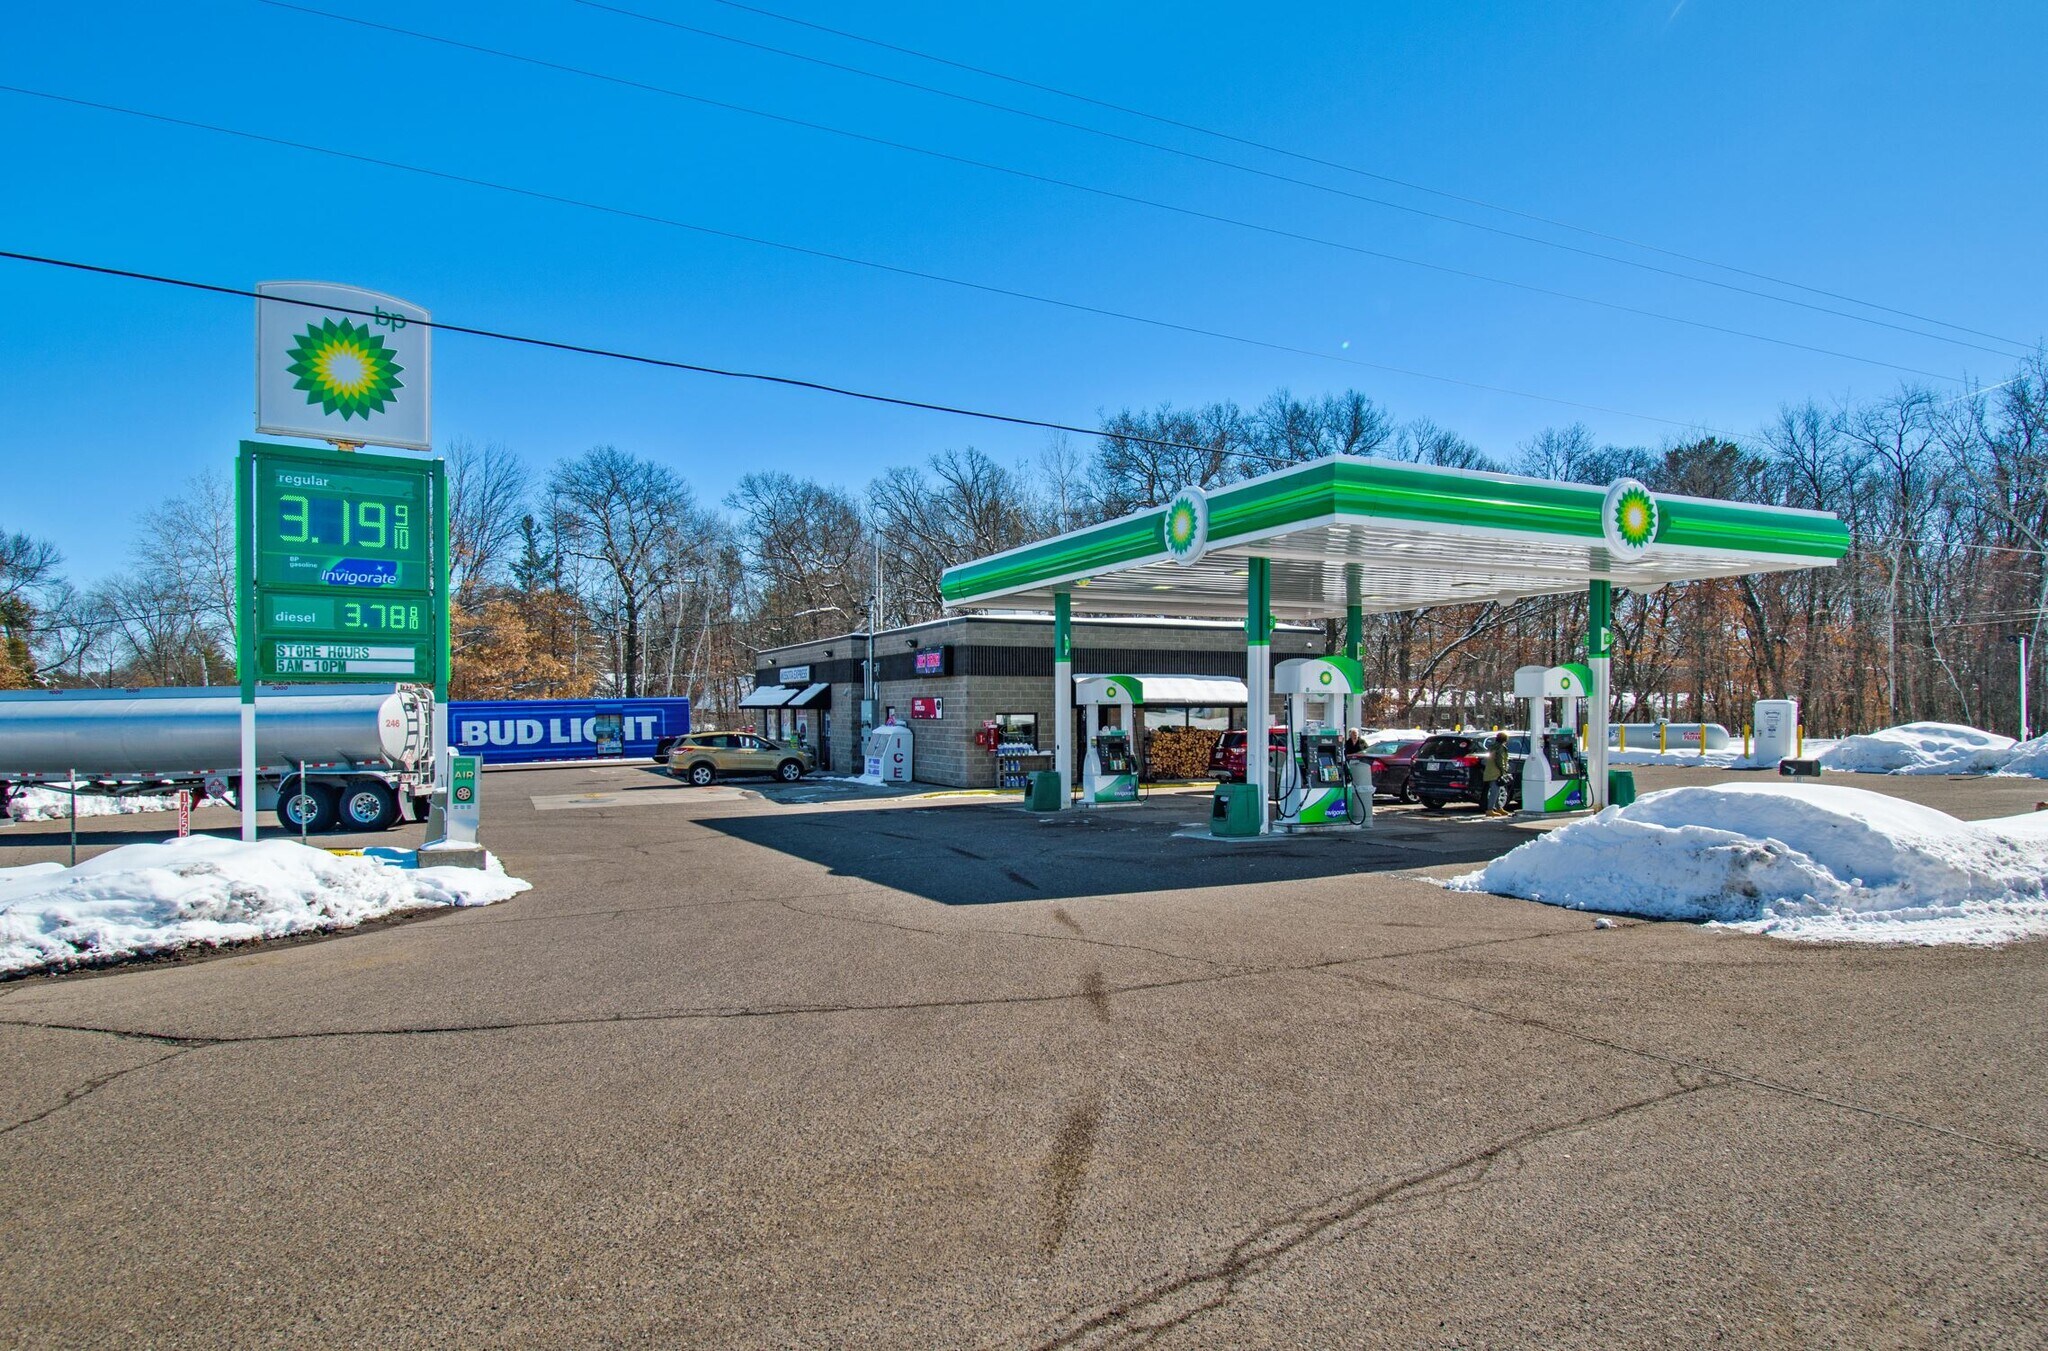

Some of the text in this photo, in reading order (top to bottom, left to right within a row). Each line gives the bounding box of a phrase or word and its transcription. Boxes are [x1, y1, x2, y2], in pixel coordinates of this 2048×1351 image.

[374, 305, 407, 332] bp
[279, 474, 329, 487] regular
[280, 494, 386, 548] 3.19
[289, 561, 318, 569] gasoline
[321, 568, 397, 585] Invigorate
[275, 612, 316, 623] diesel
[345, 602, 406, 629] 3.78
[278, 645, 370, 658] STORE HOURS
[385, 719, 400, 728] 246
[461, 719, 544, 746] BUD
[893, 738, 904, 778] ICE
[455, 770, 474, 779] AIR
